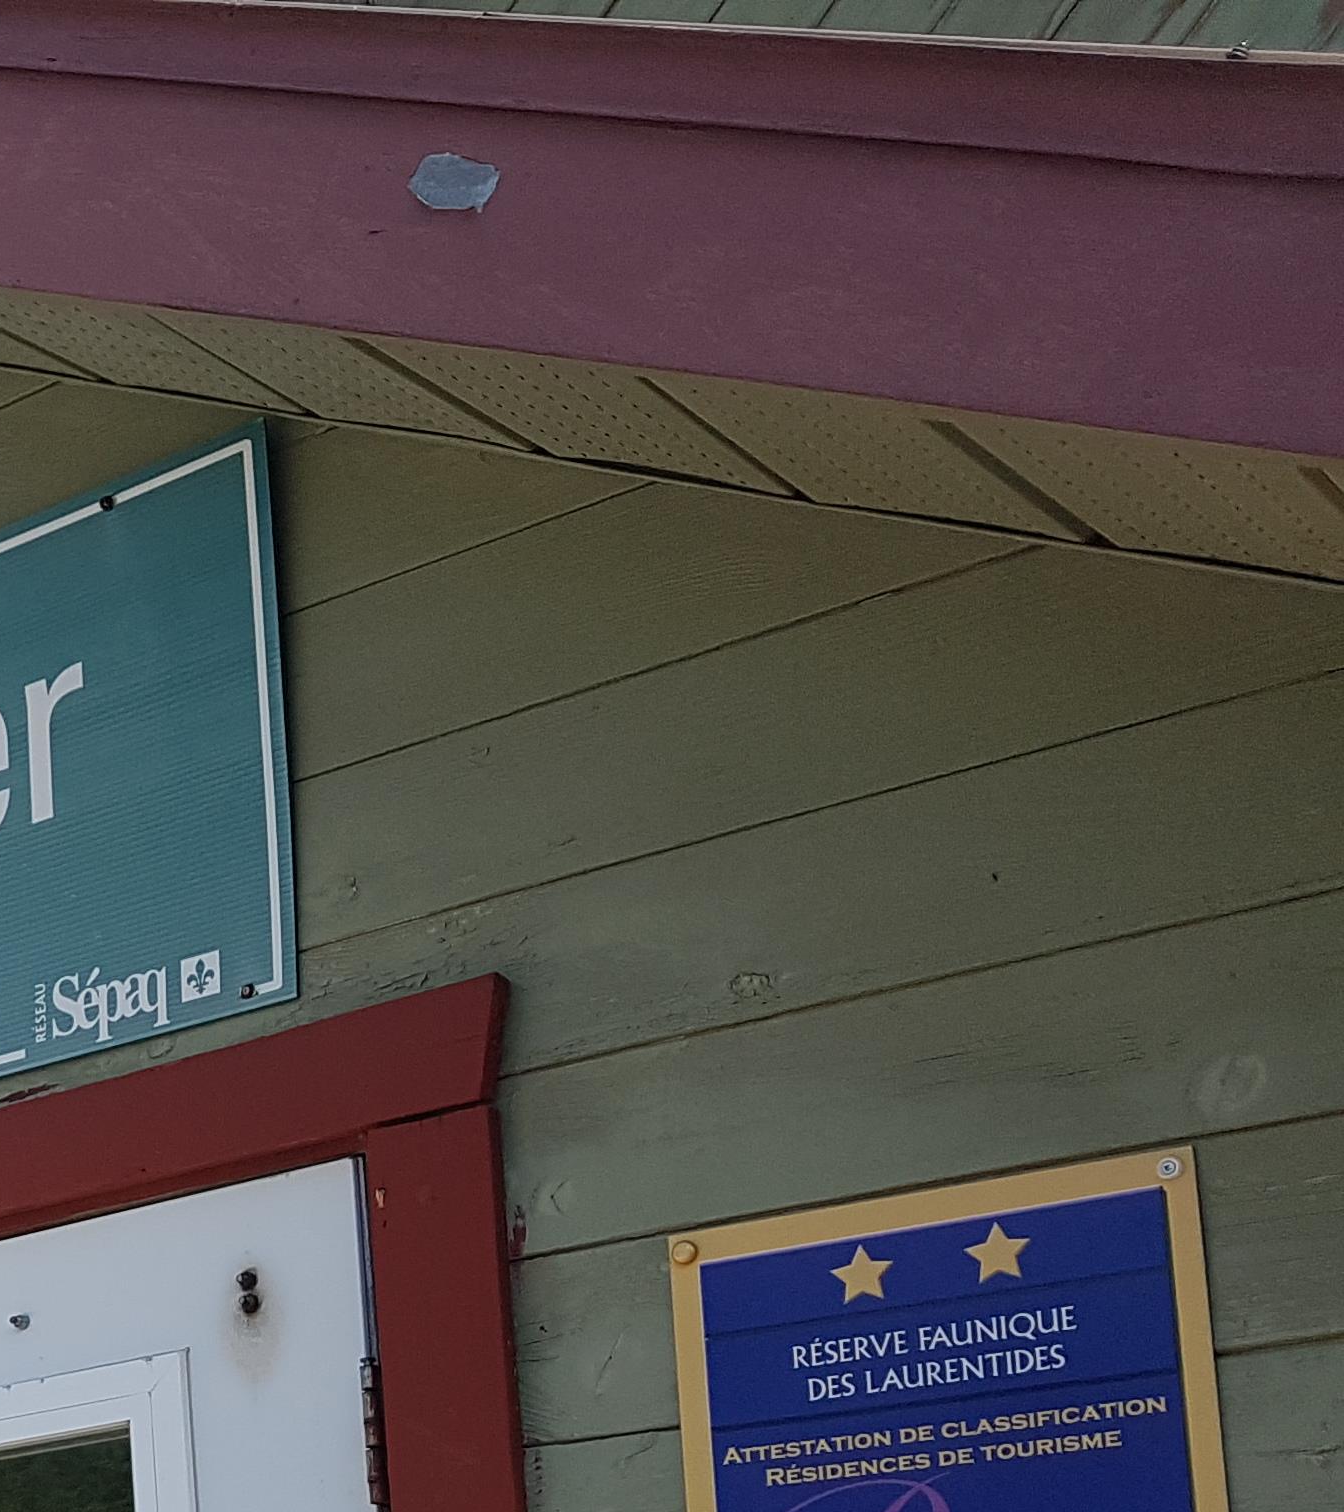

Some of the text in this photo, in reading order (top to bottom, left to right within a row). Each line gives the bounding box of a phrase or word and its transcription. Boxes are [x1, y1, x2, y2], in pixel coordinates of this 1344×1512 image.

[32, 984, 47, 1044] RÉSEAU
[51, 966, 171, 1043] Sépaq
[791, 1305, 1078, 1369] RÉSERVE FAUNIQUE
[807, 1344, 1066, 1402] DES LAURENTIDES
[722, 1396, 1168, 1466] ATTESTATION DE CLASSIFICATION
[765, 1430, 1123, 1487] RÉSIDENCES DE TOURISME
